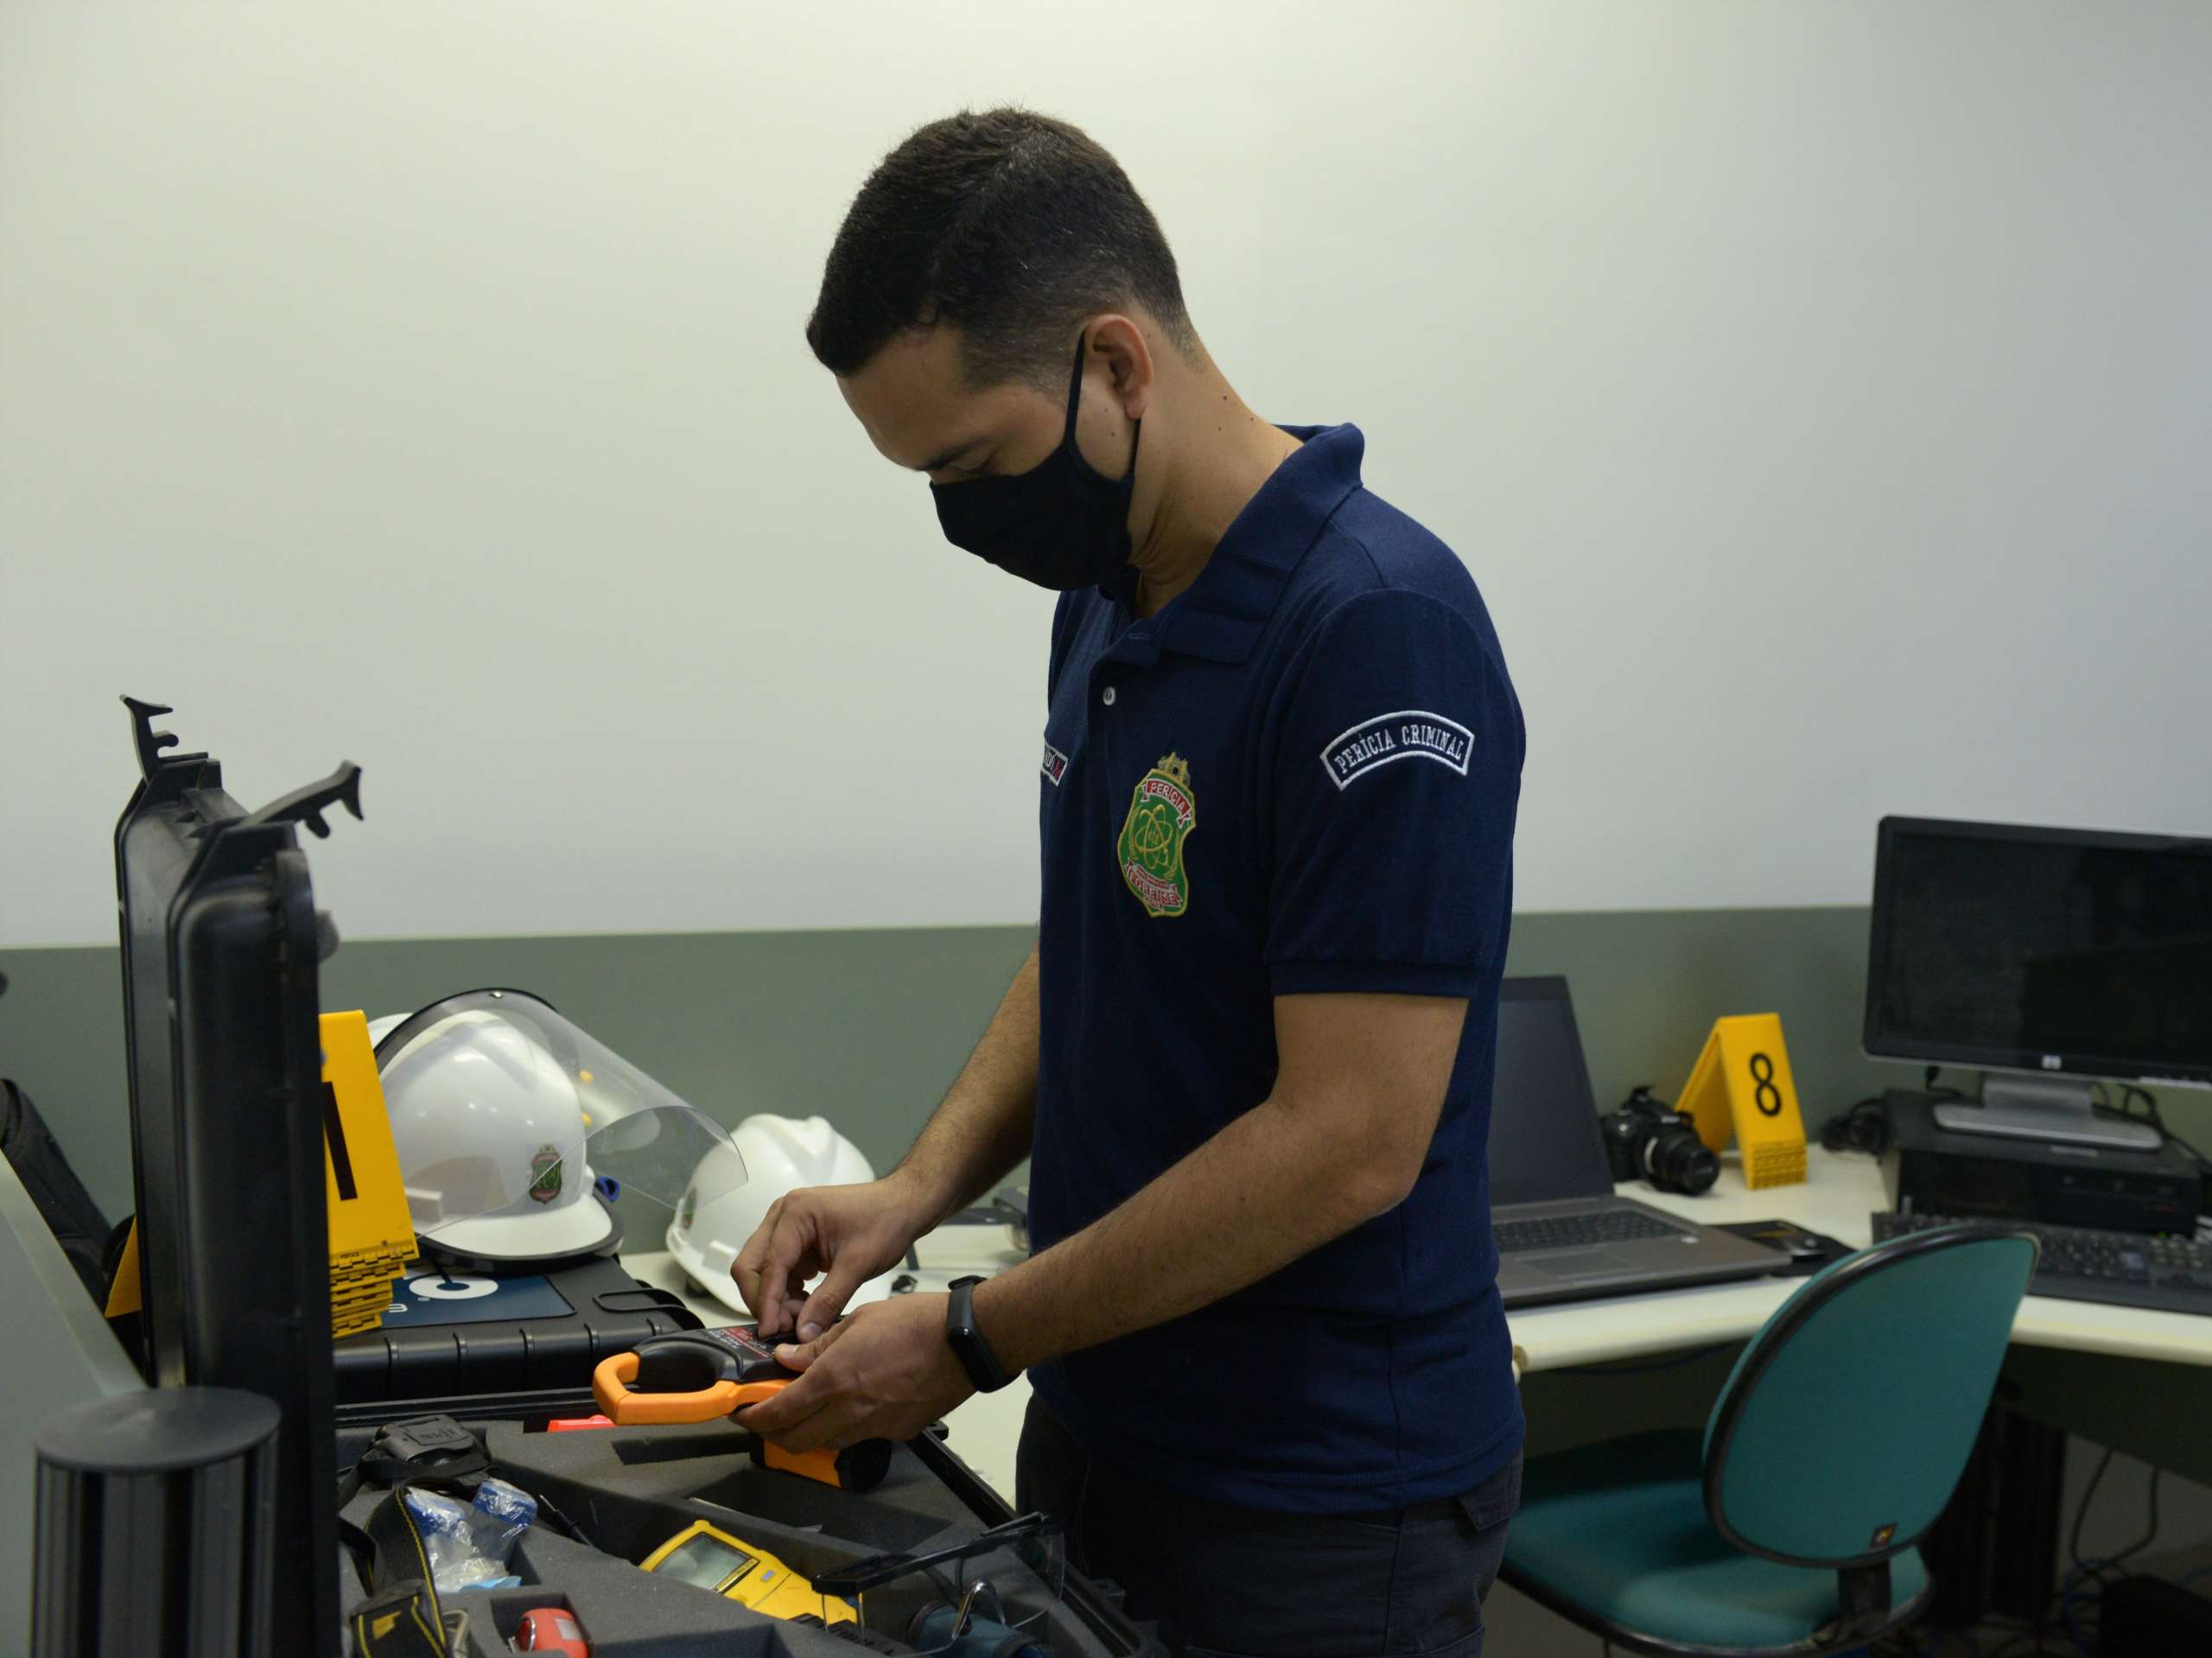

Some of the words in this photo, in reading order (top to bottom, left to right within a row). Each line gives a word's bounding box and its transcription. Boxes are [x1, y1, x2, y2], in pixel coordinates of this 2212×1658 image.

[1334, 728, 1396, 774] PERÍCIA
[1402, 724, 1465, 760] CRIMINAL
[1750, 1052, 1783, 1117] 8
